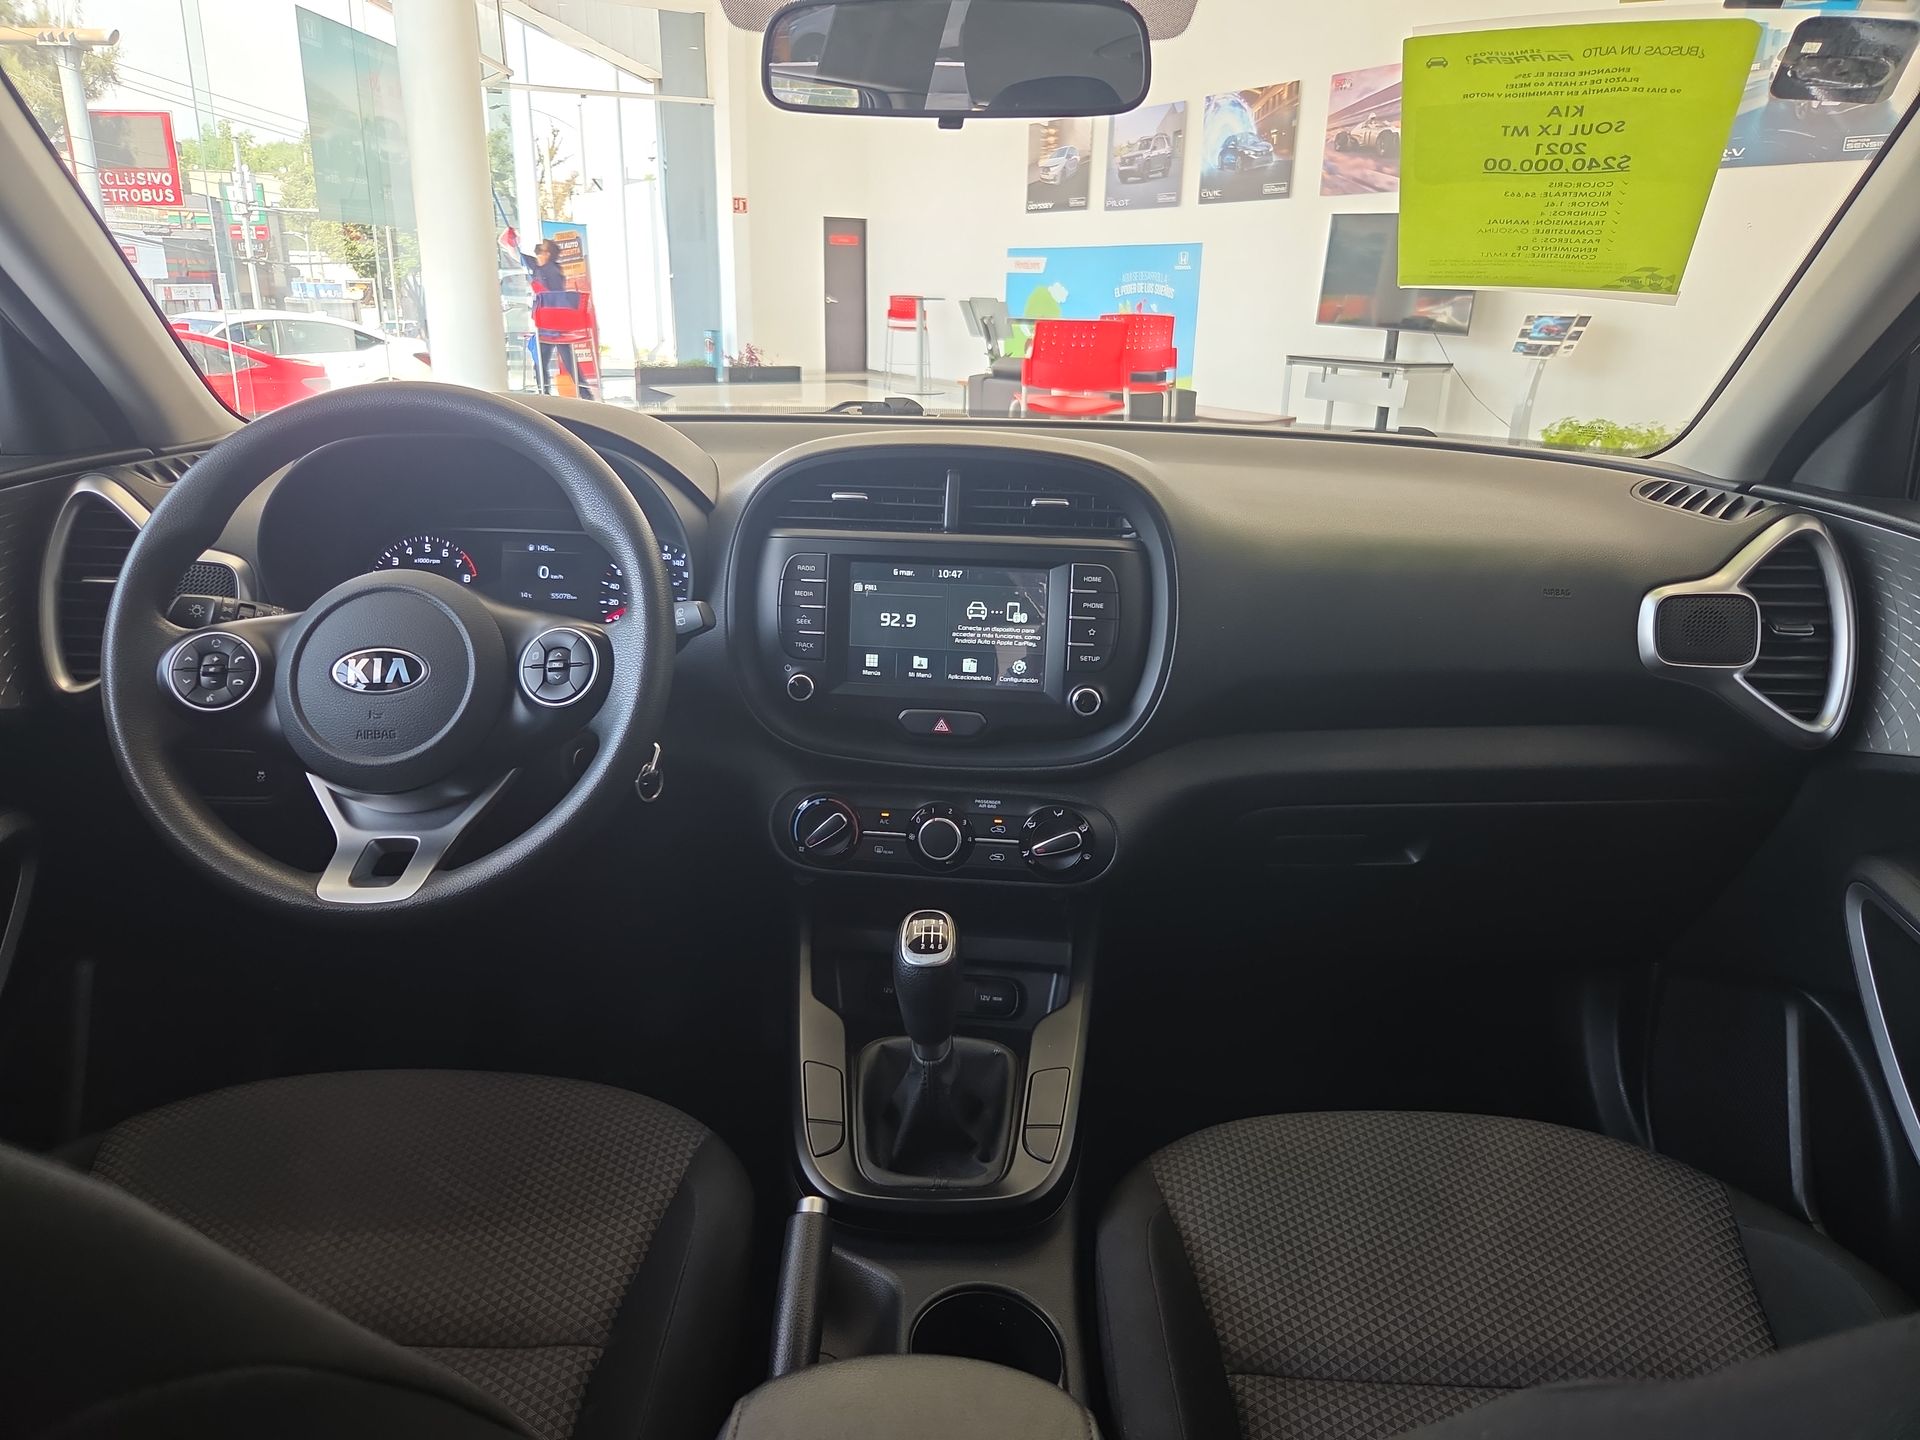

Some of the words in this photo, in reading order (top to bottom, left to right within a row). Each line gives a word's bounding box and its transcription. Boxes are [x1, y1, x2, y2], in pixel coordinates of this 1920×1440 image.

[98, 172, 172, 186] XCLUSIVO
[101, 188, 175, 202] ETROBUS
[1201, 189, 1223, 197] CIVIC
[1027, 202, 1055, 210] ODYSSEY
[1105, 199, 1130, 207] PILOT
[406, 546, 413, 556] 4
[424, 544, 432, 553] 5
[442, 549, 449, 558] 6
[392, 557, 399, 566] 3
[455, 559, 463, 568] 7
[672, 559, 685, 567] 140
[538, 565, 550, 579] 0
[899, 569, 916, 577] mar.
[938, 569, 963, 579] 10:47
[463, 574, 471, 583] 8
[609, 583, 620, 591] 40
[1543, 588, 1571, 597] AIRBAG
[880, 612, 917, 628] 92.9
[957, 624, 982, 632] Conecte
[991, 625, 1020, 634] dispositivo
[1021, 627, 1035, 635] para
[954, 637, 977, 645] Android
[996, 639, 1013, 647] Apple
[347, 657, 411, 684] KIA
[948, 673, 992, 682] Aplicaciones/Info
[999, 676, 1039, 684] Configuración
[355, 729, 396, 740] AIRBAG
